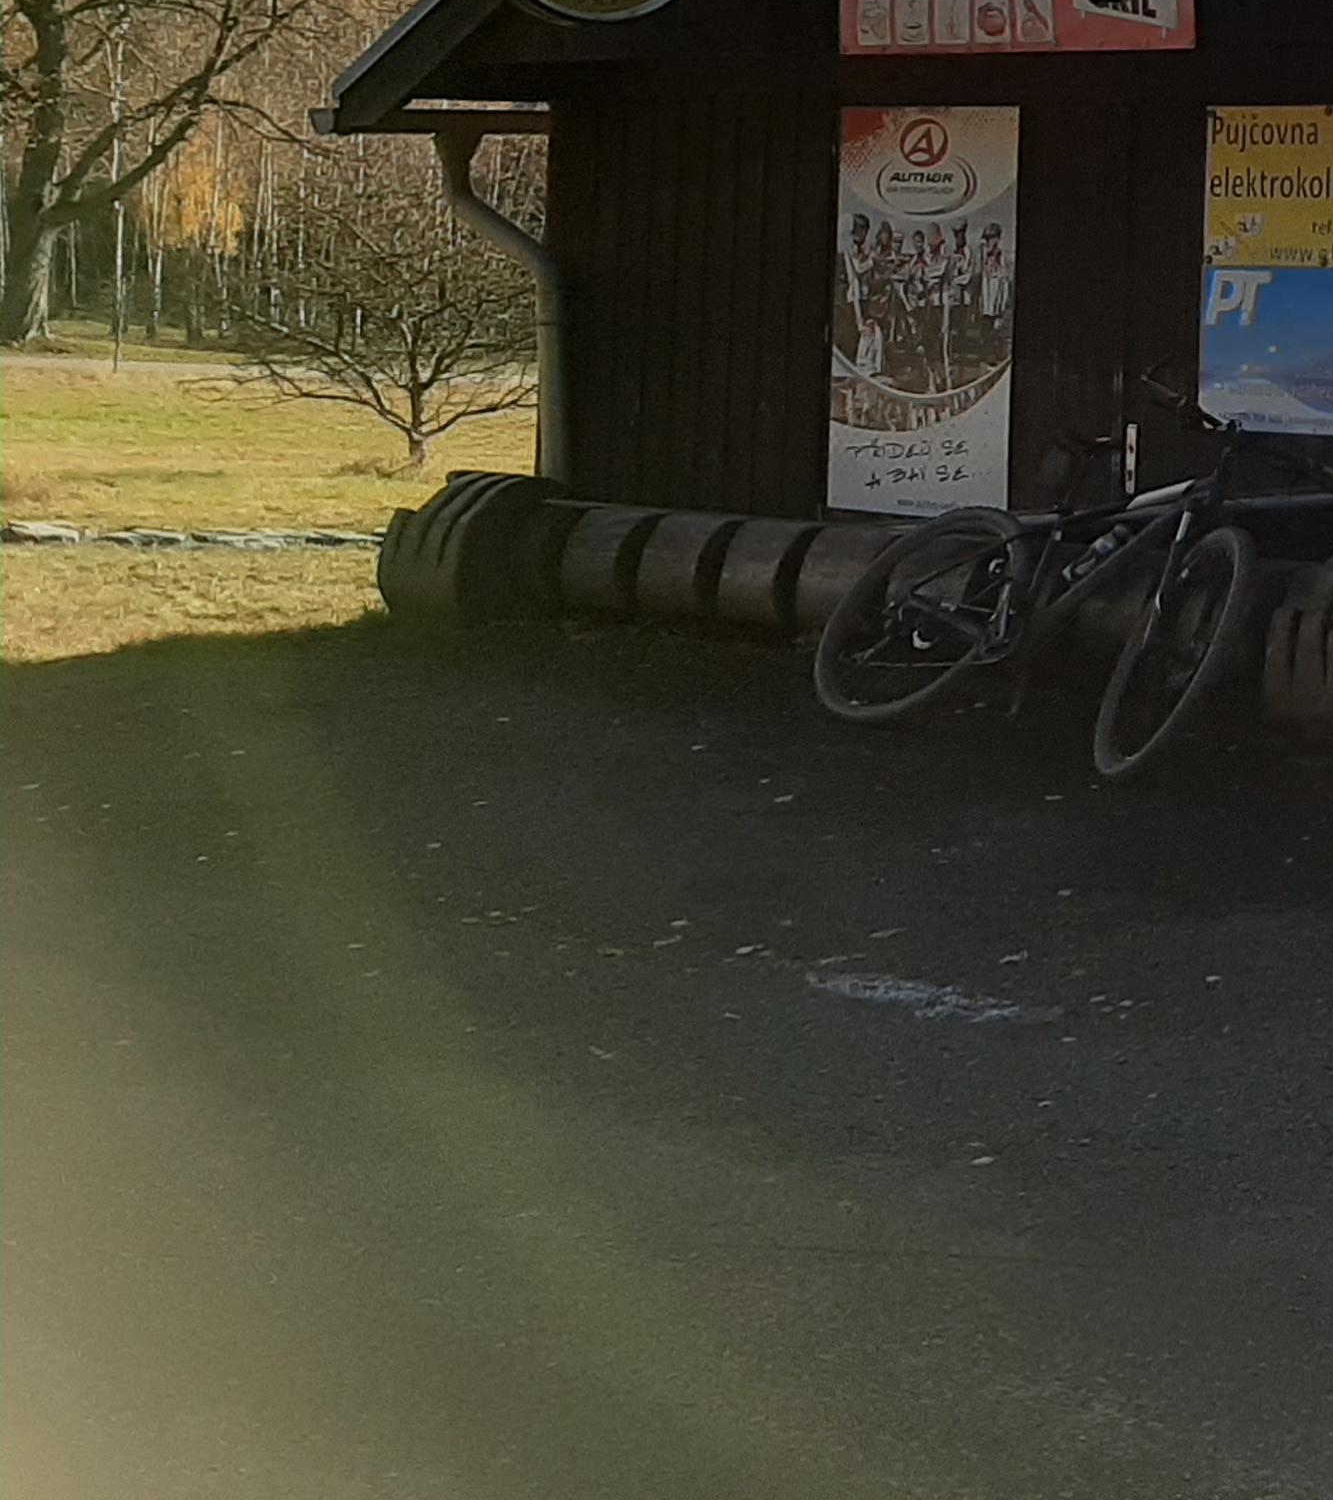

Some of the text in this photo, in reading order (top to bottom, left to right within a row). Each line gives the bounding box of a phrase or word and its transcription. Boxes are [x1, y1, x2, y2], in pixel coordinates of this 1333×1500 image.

[889, 171, 954, 183] AUTHOR
[1210, 166, 1332, 199] elektrokol
[942, 439, 969, 456] SE
